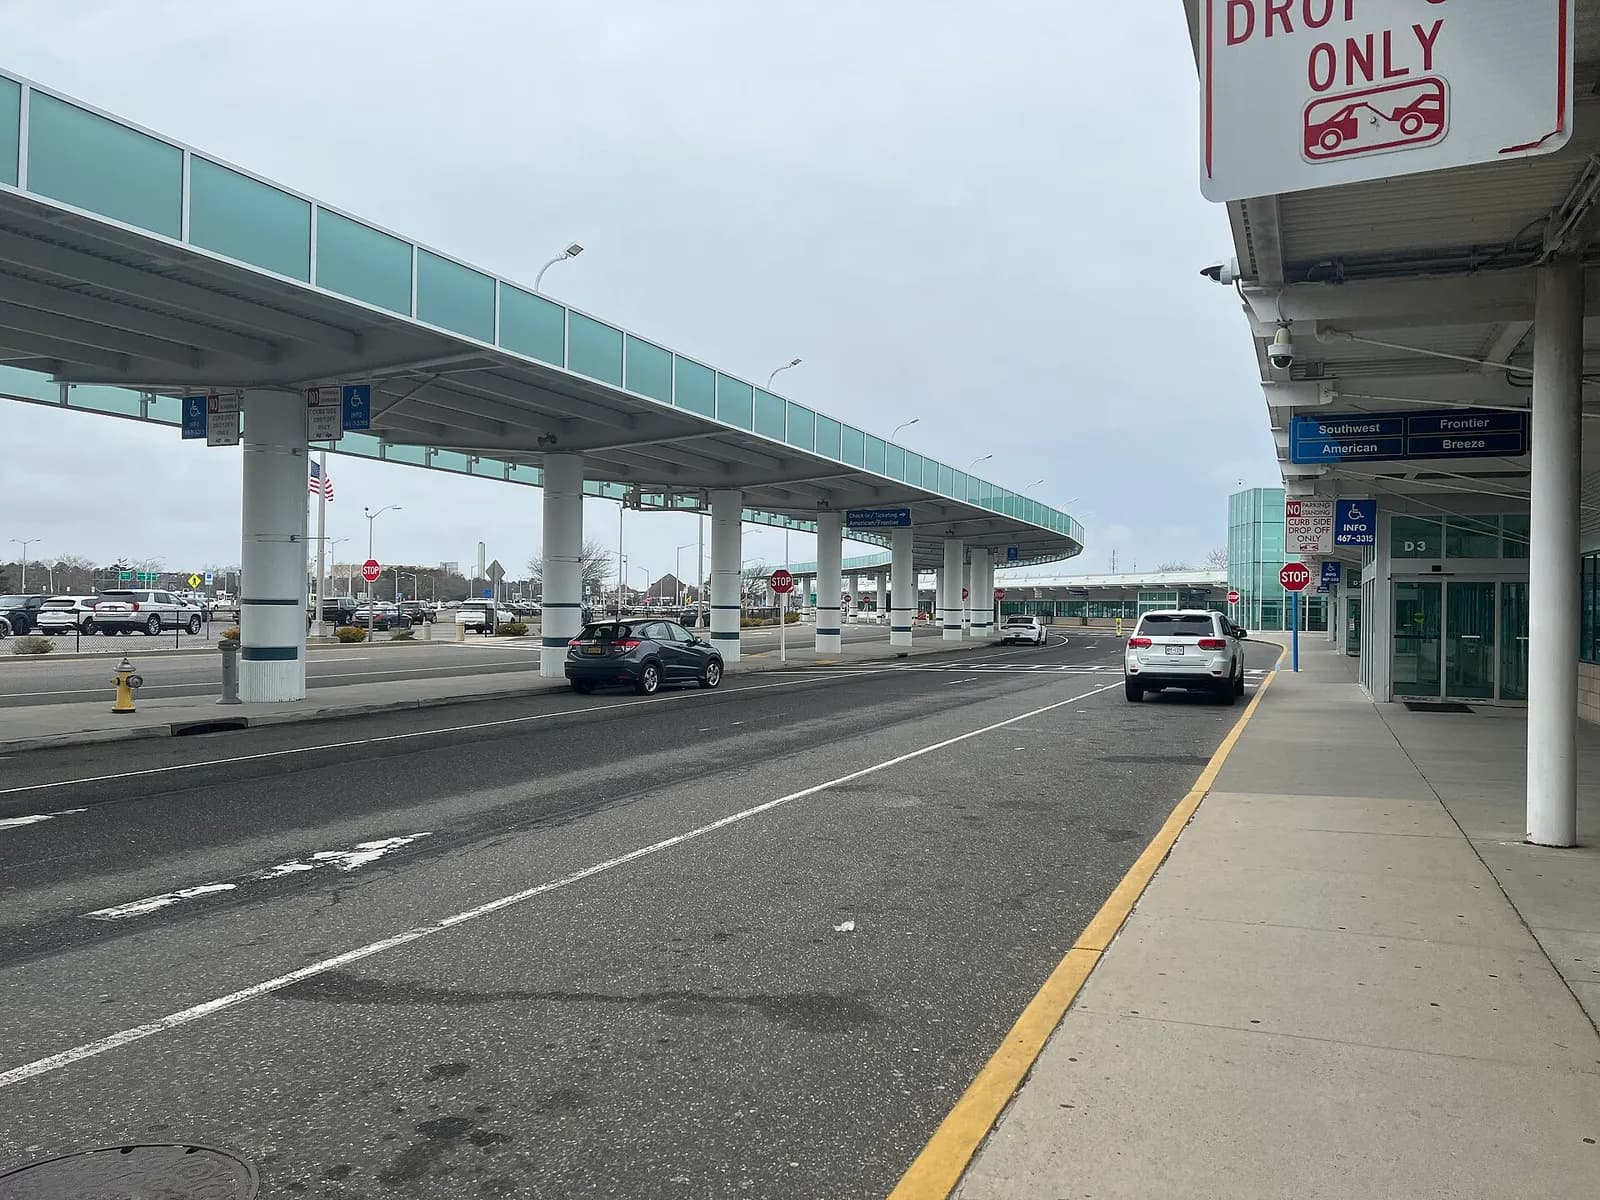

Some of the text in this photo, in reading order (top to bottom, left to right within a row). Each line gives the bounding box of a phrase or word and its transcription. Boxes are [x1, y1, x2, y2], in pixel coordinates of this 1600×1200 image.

[1308, 19, 1444, 92] ONLY
[1319, 424, 1380, 434] Southwest
[1440, 418, 1490, 429] Frontier
[1322, 443, 1377, 454] American
[1442, 439, 1485, 449] Breeze
[1287, 504, 1300, 515] NO
[363, 566, 380, 575] STOP
[771, 577, 791, 587] STOP
[1281, 571, 1308, 583] STOP
